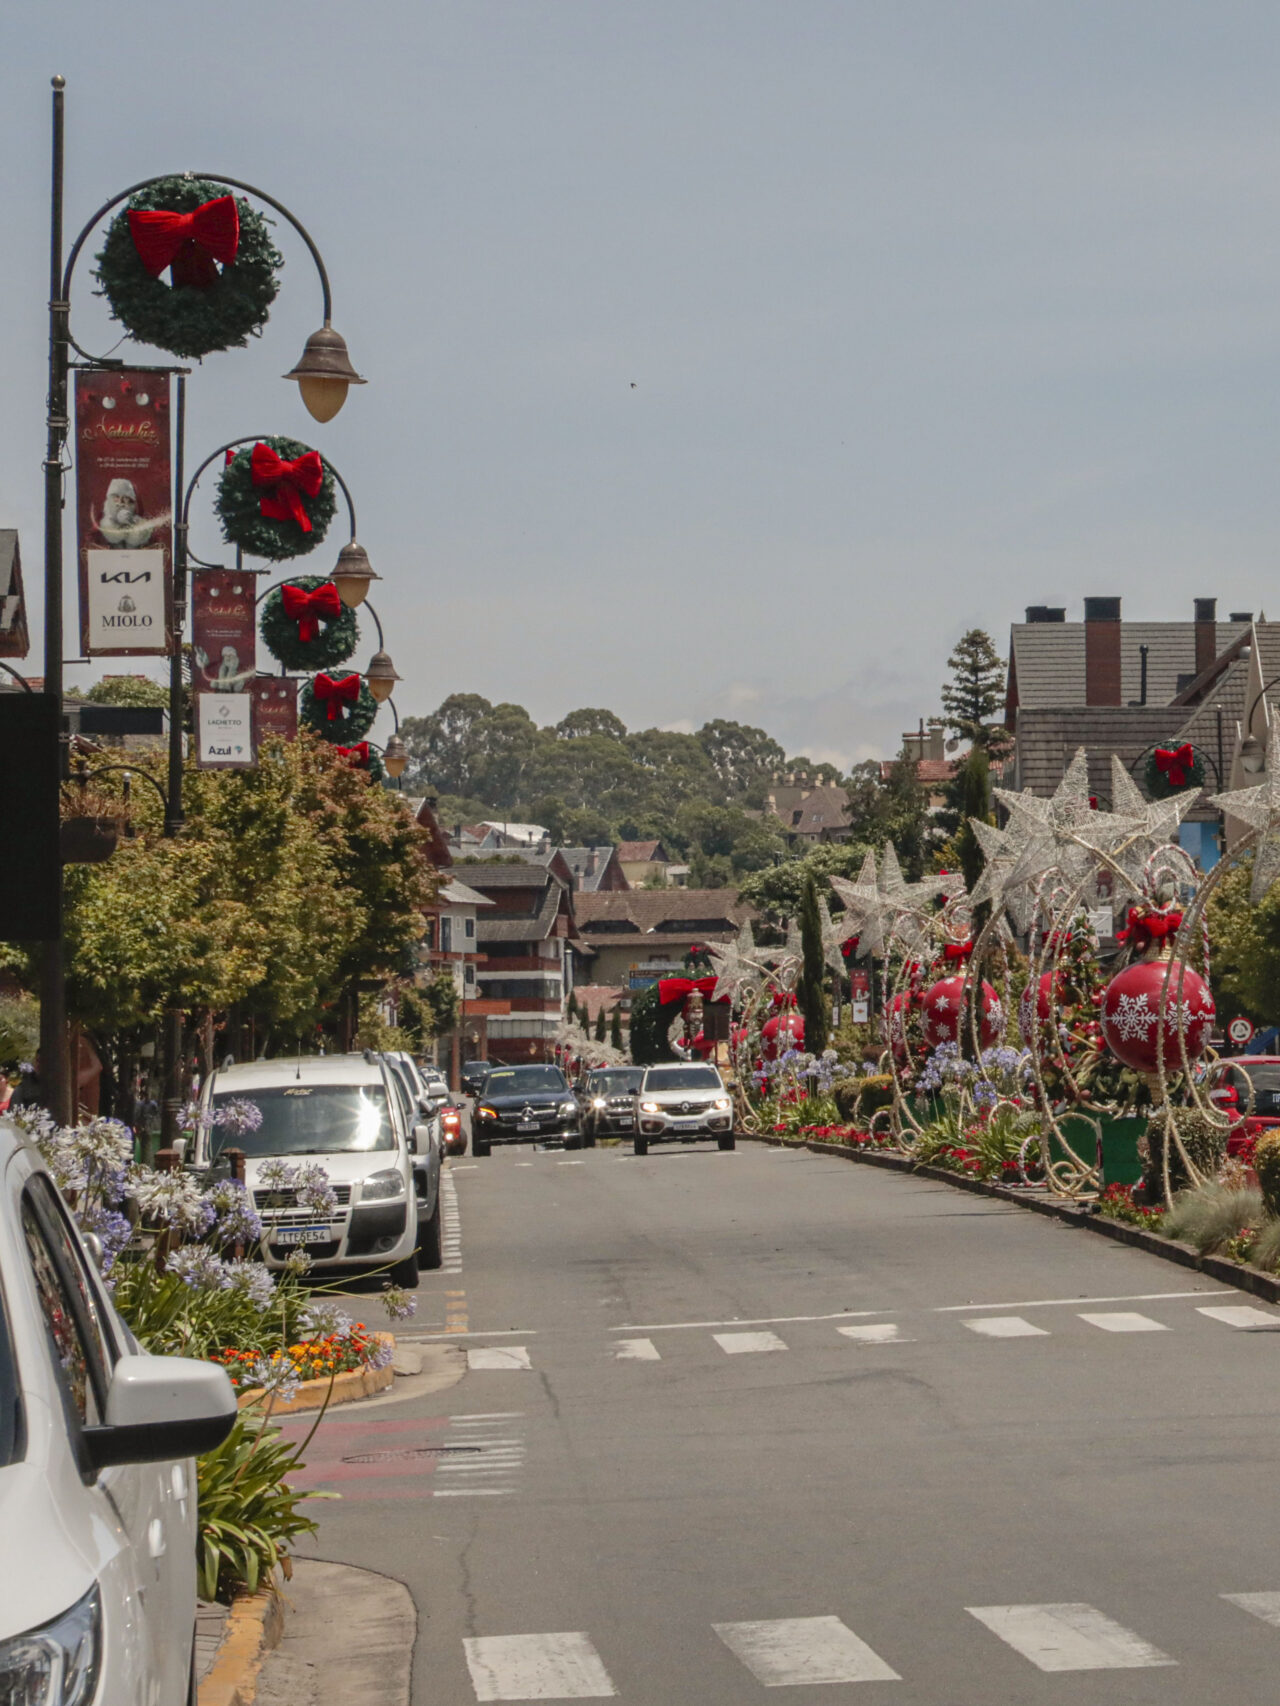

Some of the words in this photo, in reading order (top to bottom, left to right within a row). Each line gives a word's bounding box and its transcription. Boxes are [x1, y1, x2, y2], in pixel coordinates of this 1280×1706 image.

[101, 571, 152, 584] KIA
[102, 615, 153, 628] MIOLO
[208, 745, 231, 755] Azul
